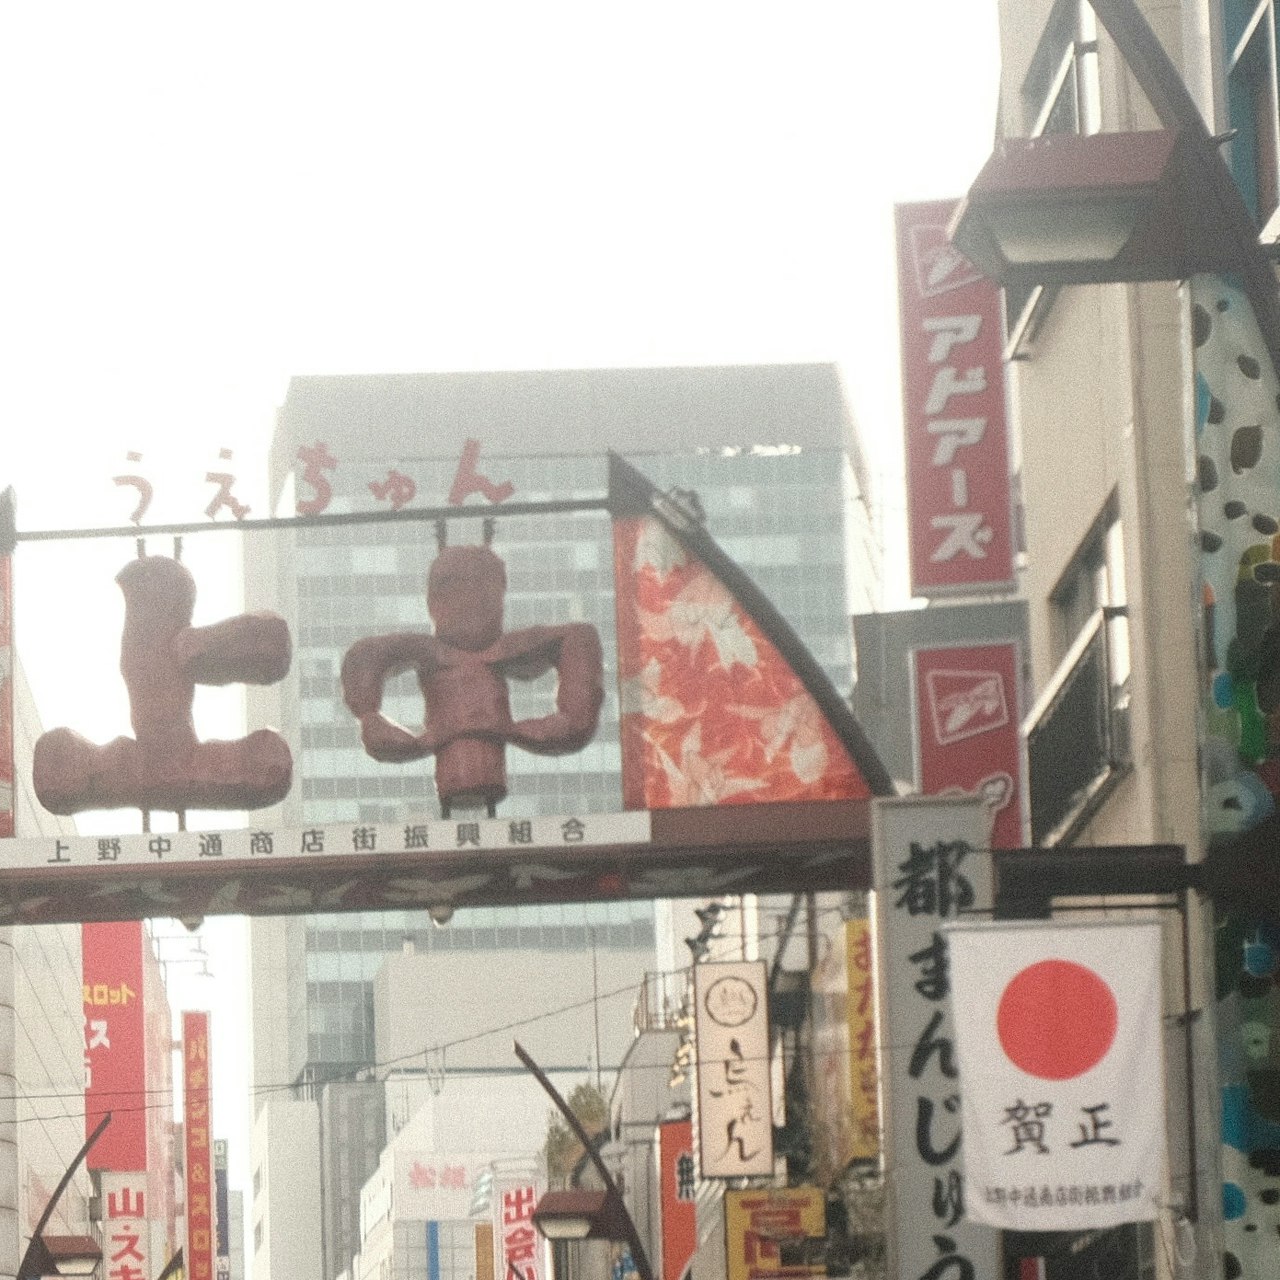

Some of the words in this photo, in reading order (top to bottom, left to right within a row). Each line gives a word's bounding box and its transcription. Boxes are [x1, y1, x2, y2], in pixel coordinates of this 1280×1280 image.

[921, 313, 994, 564] アドアーズ
[47, 817, 588, 865] 上野中通商店街振興組合
